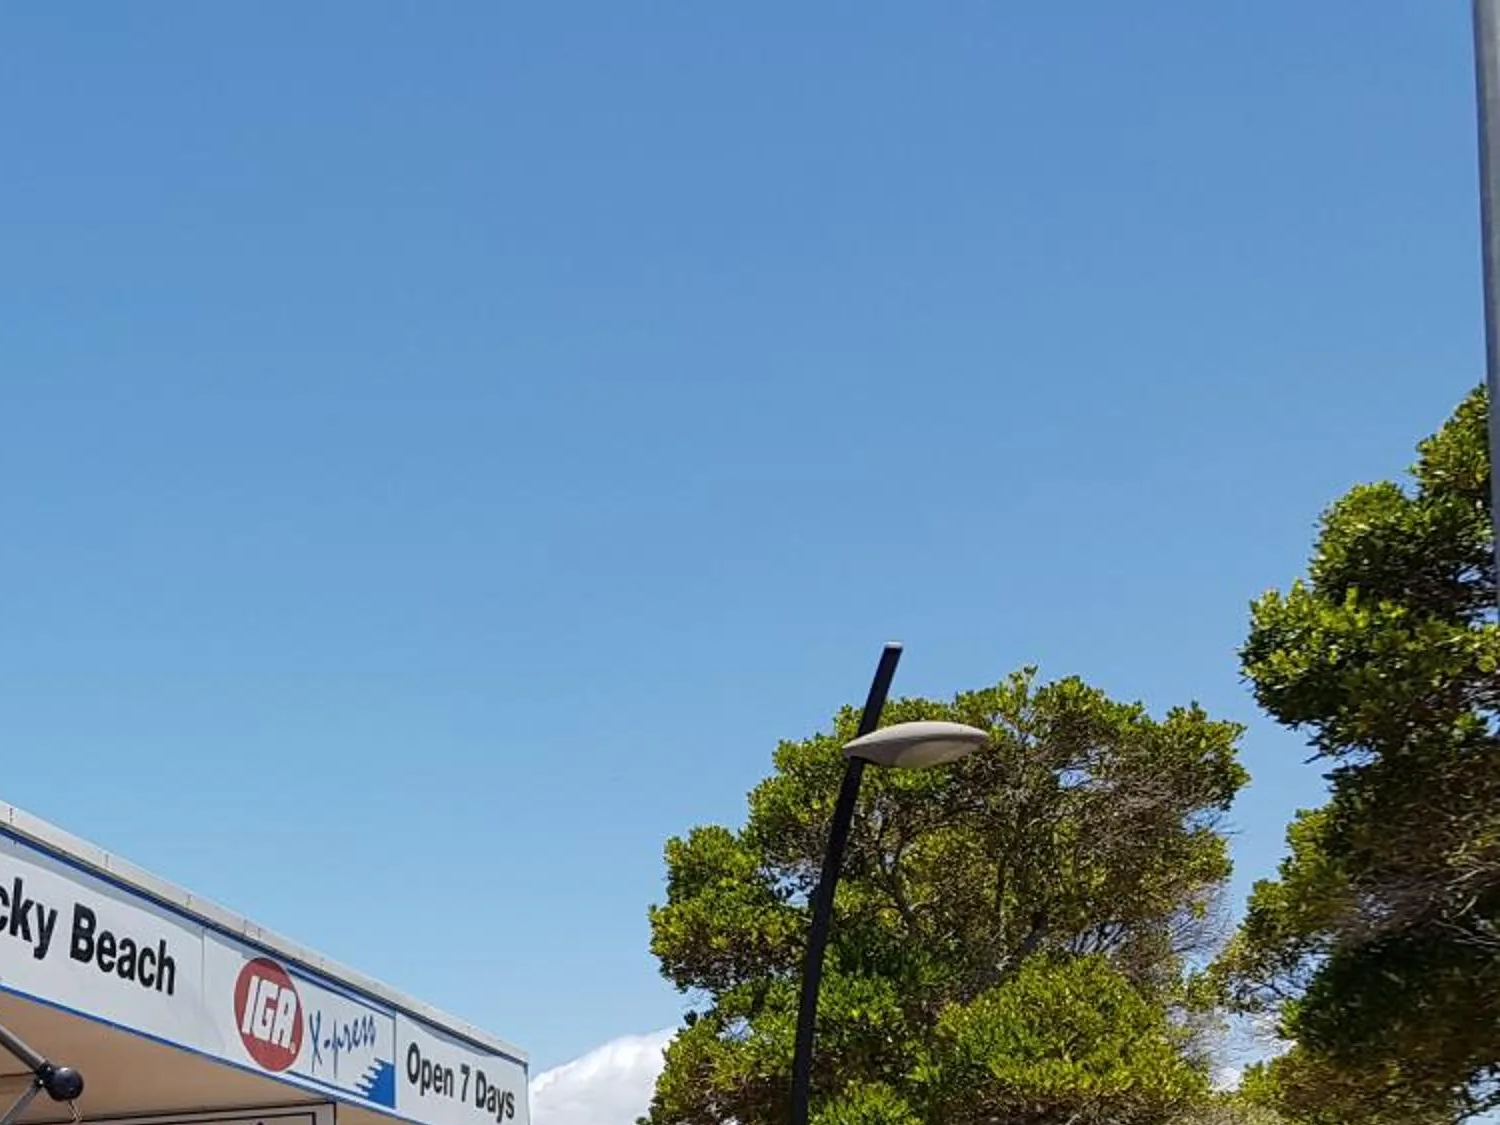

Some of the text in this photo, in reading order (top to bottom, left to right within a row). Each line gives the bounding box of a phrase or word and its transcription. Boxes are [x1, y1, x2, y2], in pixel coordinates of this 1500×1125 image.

[70, 903, 176, 995] Beach
[241, 975, 377, 1073] IGA X-press
[406, 1041, 516, 1123] Open 7 Days
